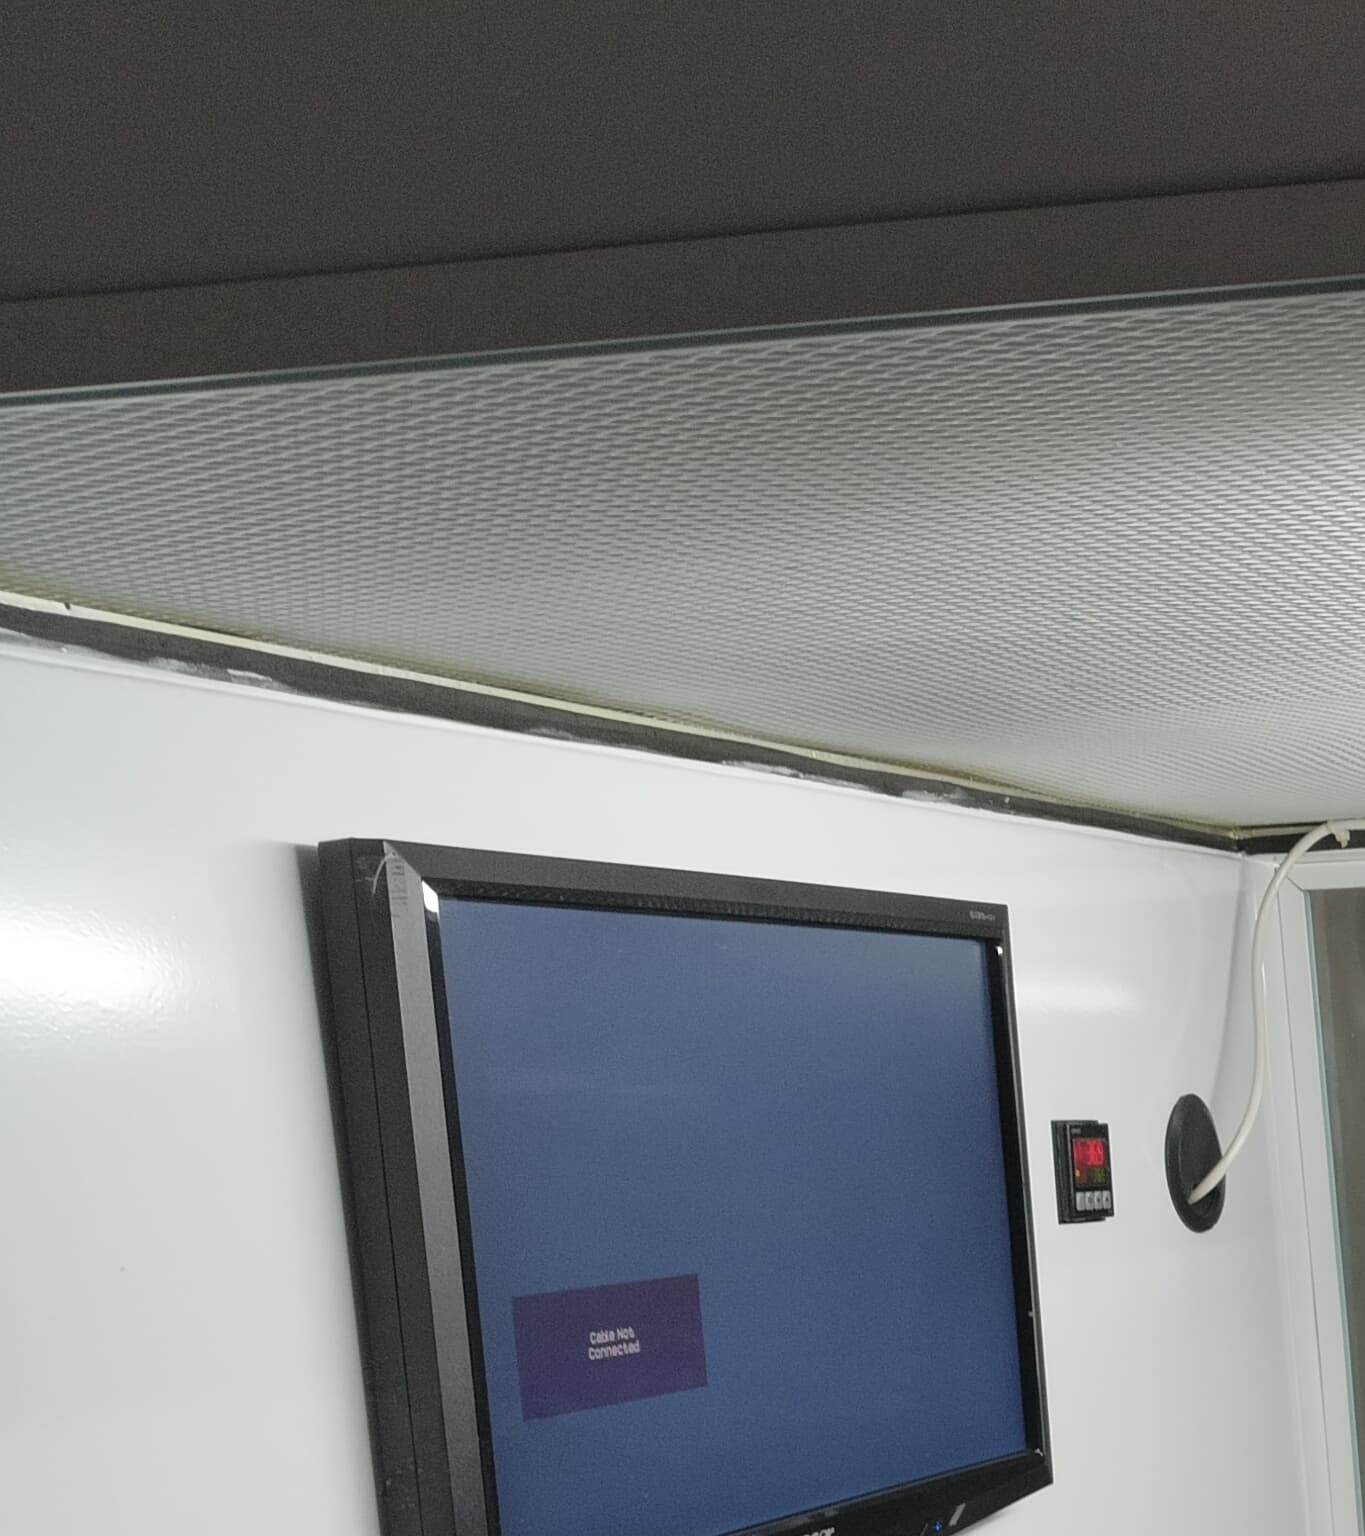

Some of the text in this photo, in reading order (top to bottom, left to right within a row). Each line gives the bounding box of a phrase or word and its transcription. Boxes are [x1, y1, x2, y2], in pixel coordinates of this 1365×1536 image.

[590, 1326, 635, 1345] Cable Not
[588, 1339, 640, 1360] Connected
